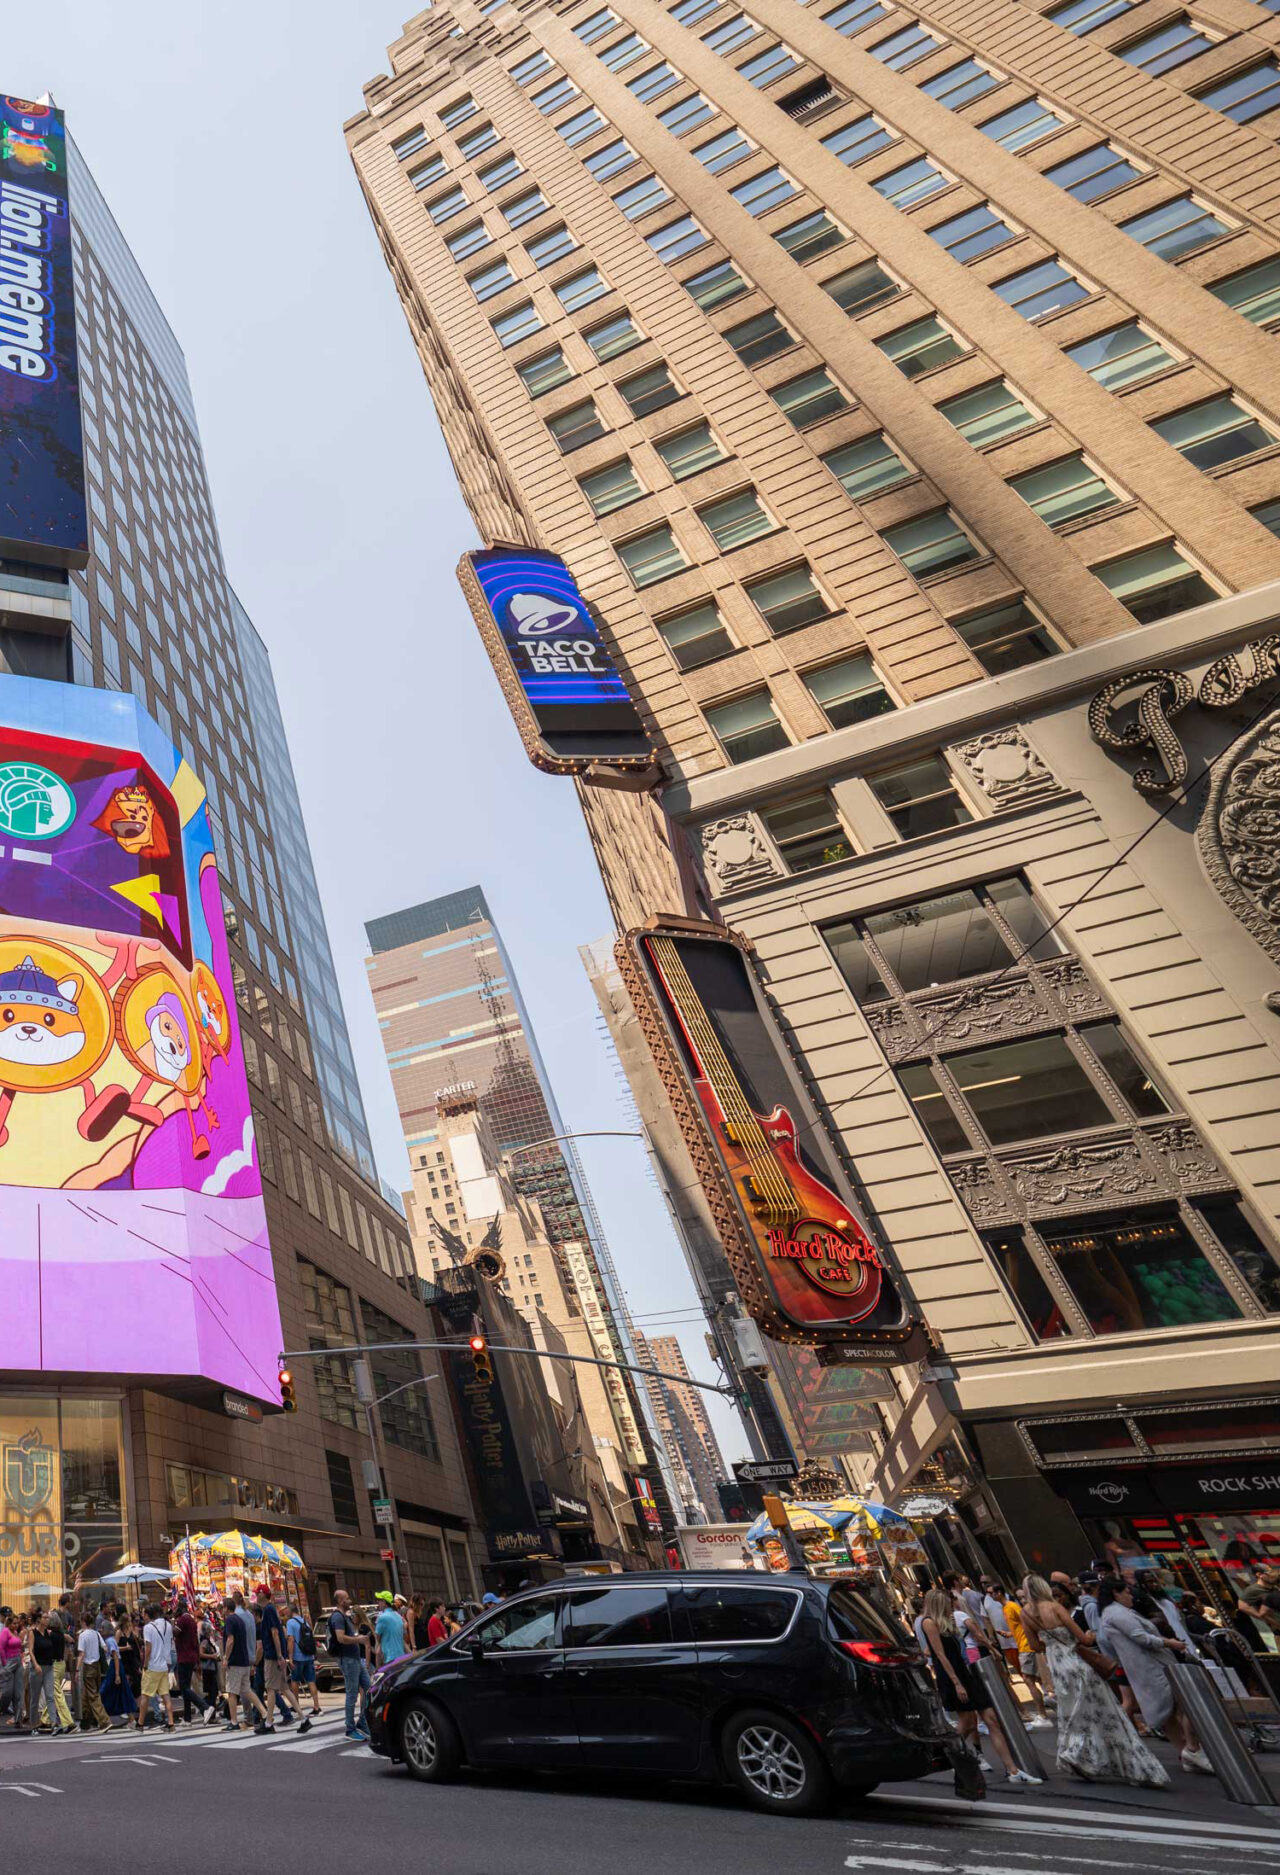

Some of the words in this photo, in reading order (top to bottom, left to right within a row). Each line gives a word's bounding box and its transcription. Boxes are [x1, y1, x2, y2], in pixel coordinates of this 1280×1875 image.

[517, 640, 596, 657] TACO
[530, 656, 607, 673] BELL
[433, 1080, 476, 1098] CARTER
[768, 1229, 823, 1260] Hard
[821, 1232, 883, 1269] Rock
[819, 1266, 853, 1282] CAFE
[843, 1349, 897, 1359] SPECTACOLOR
[597, 1343, 642, 1453] CARTER
[463, 1381, 492, 1430] Harry
[479, 1422, 504, 1468] Potter
[743, 1466, 764, 1478] ONE
[769, 1464, 790, 1476] WAY
[1088, 1486, 1109, 1497] Hard
[1109, 1485, 1131, 1496] Rock
[1198, 1478, 1252, 1493] ROCK
[495, 1535, 518, 1551] Harry
[516, 1531, 542, 1548] Potter
[697, 1533, 741, 1543] Gordon
